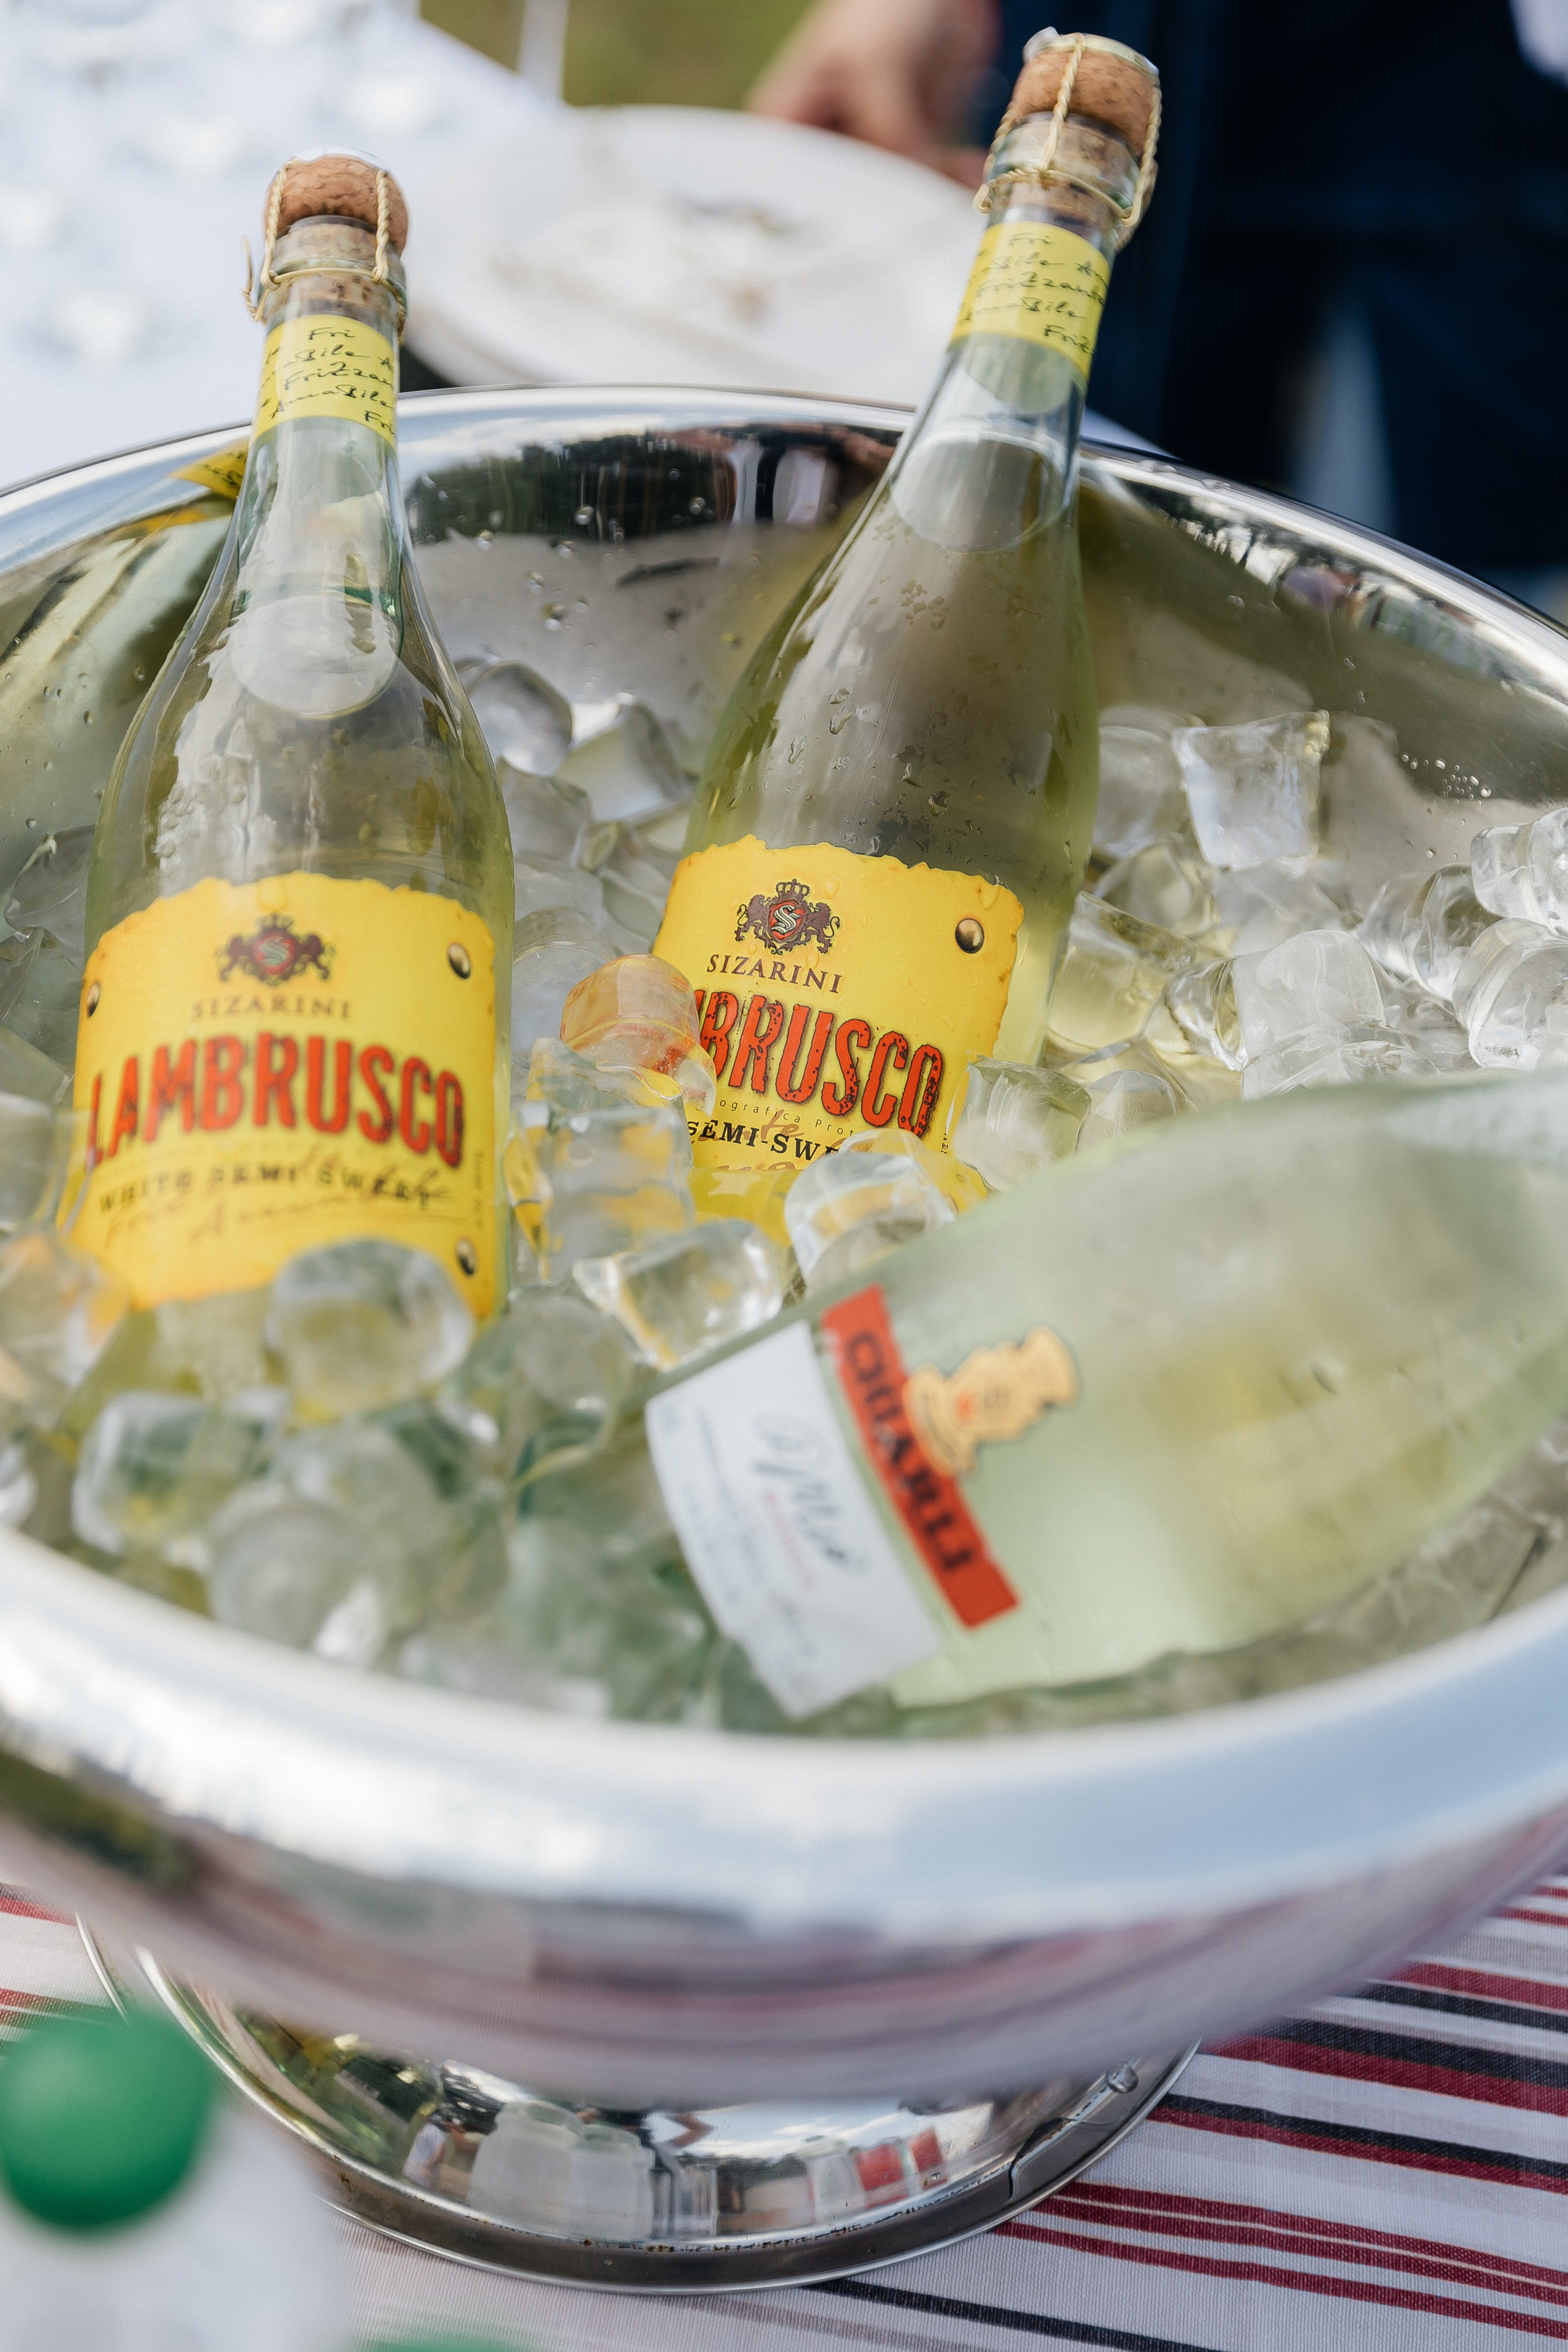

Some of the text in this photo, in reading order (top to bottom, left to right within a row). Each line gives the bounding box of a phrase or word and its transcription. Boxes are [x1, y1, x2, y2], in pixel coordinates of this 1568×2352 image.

[706, 954, 843, 994] SIZARINI
[190, 995, 353, 1022] SIZARINI
[694, 989, 943, 1137] BRUSCO
[86, 1031, 466, 1169] LAMBRUSCO
[719, 1099, 855, 1137] ografica Prot
[687, 1119, 840, 1162] SEMI-SW
